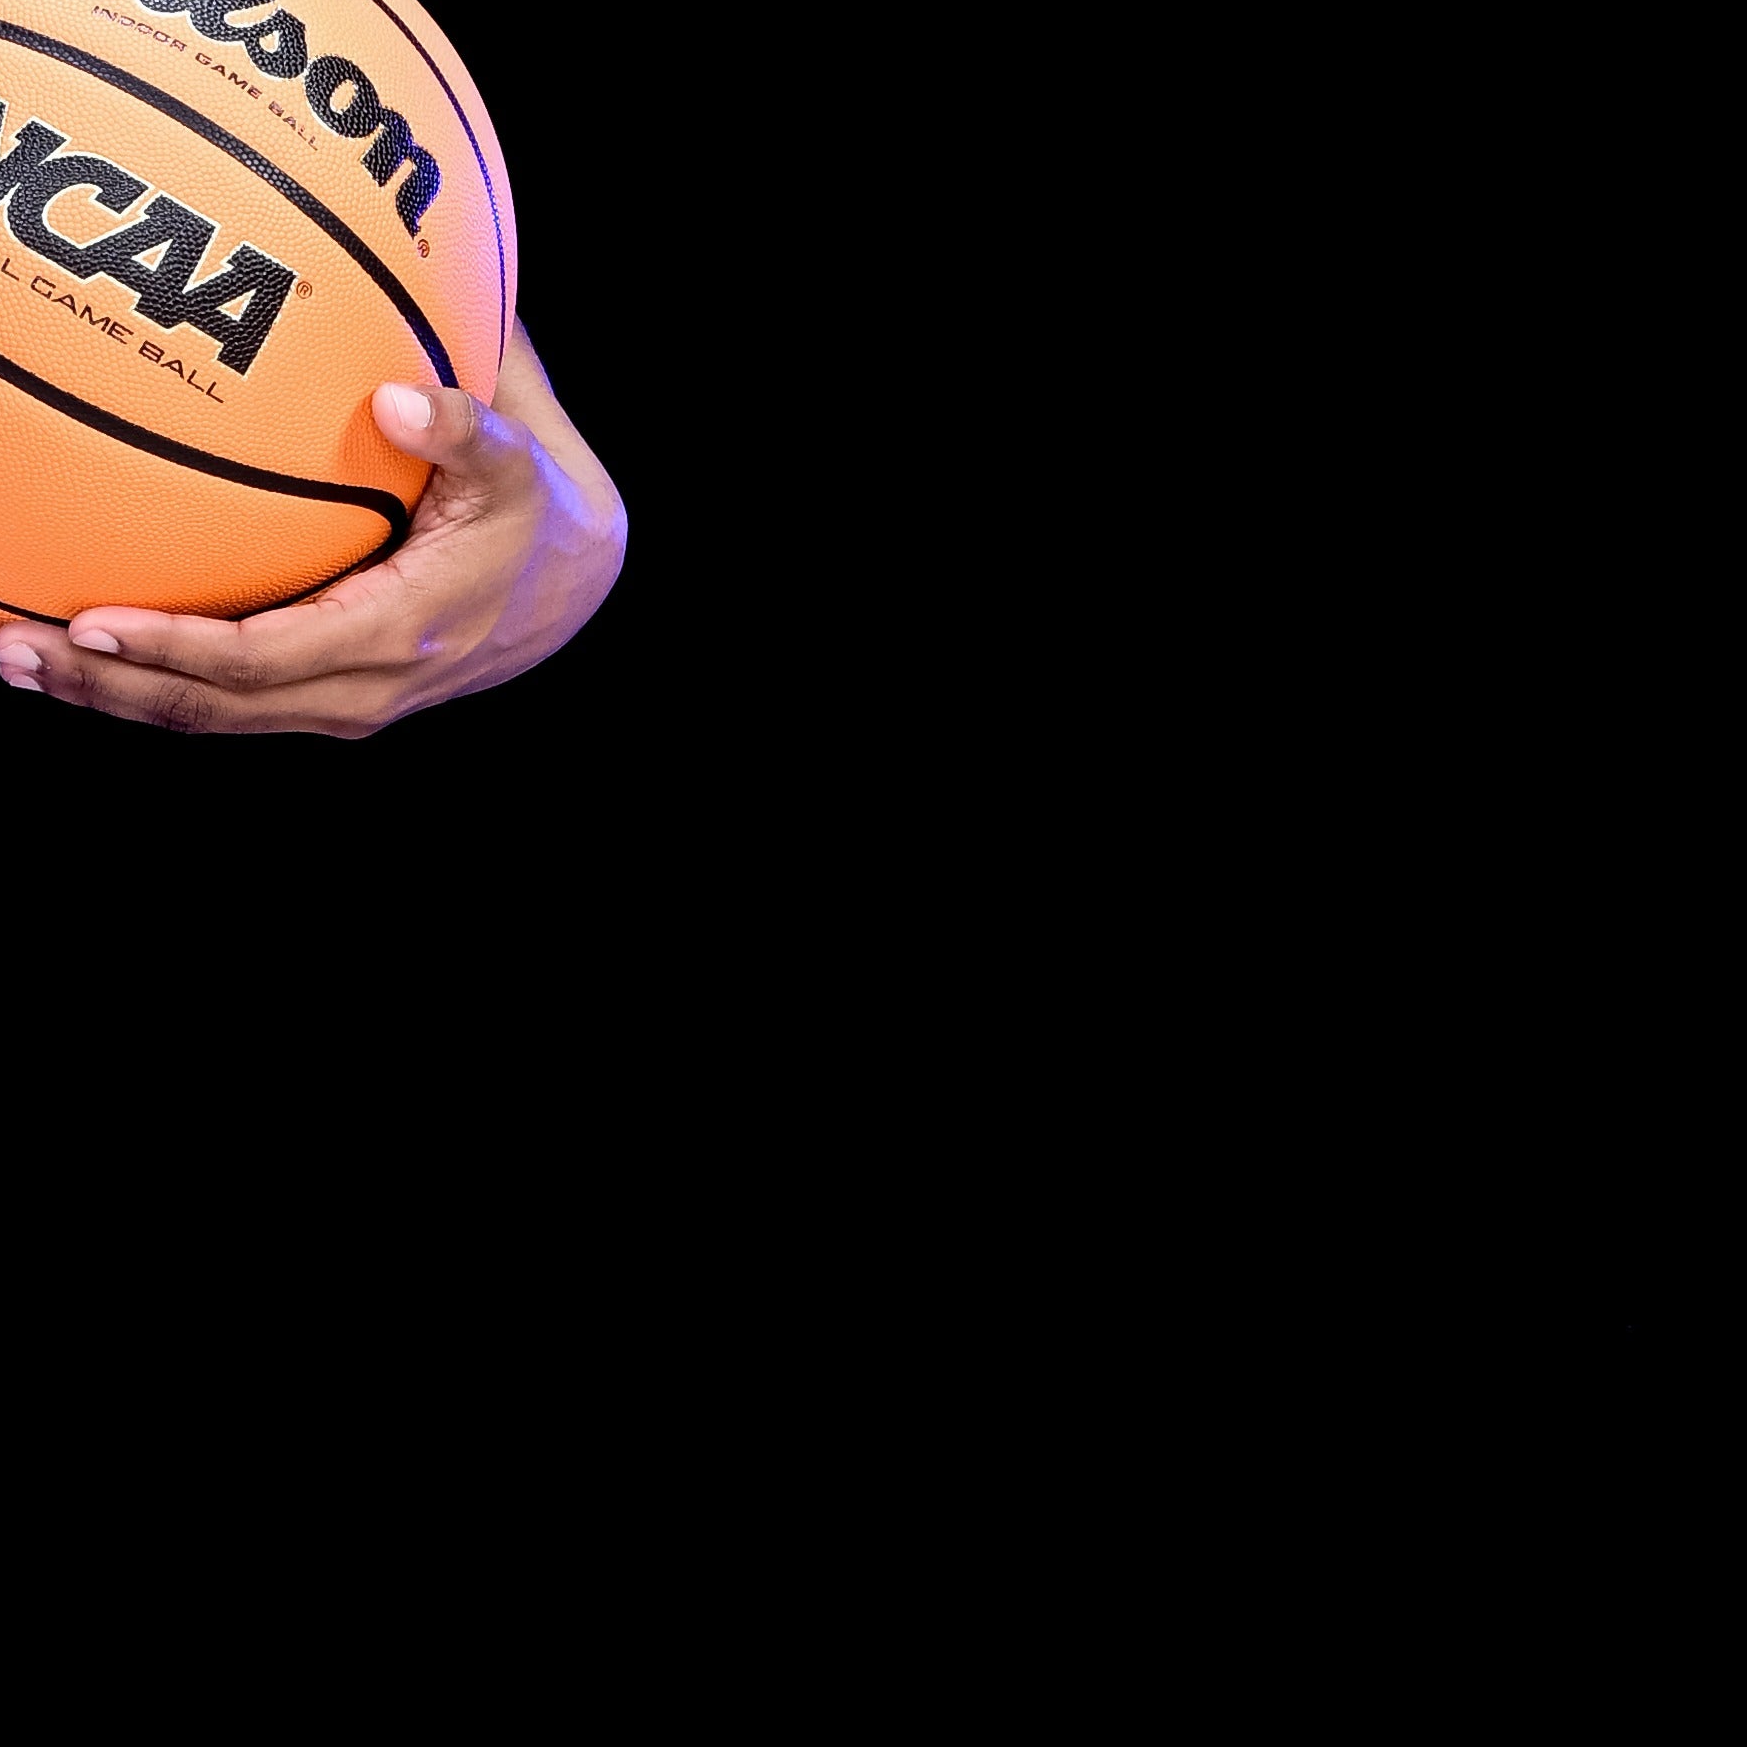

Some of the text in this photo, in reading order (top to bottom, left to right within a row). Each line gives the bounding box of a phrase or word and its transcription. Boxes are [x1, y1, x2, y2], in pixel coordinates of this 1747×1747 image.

[91, 5, 318, 151] INDOOR GAME BALL
[30, 275, 135, 345] GAME
[138, 340, 224, 404] BALL
